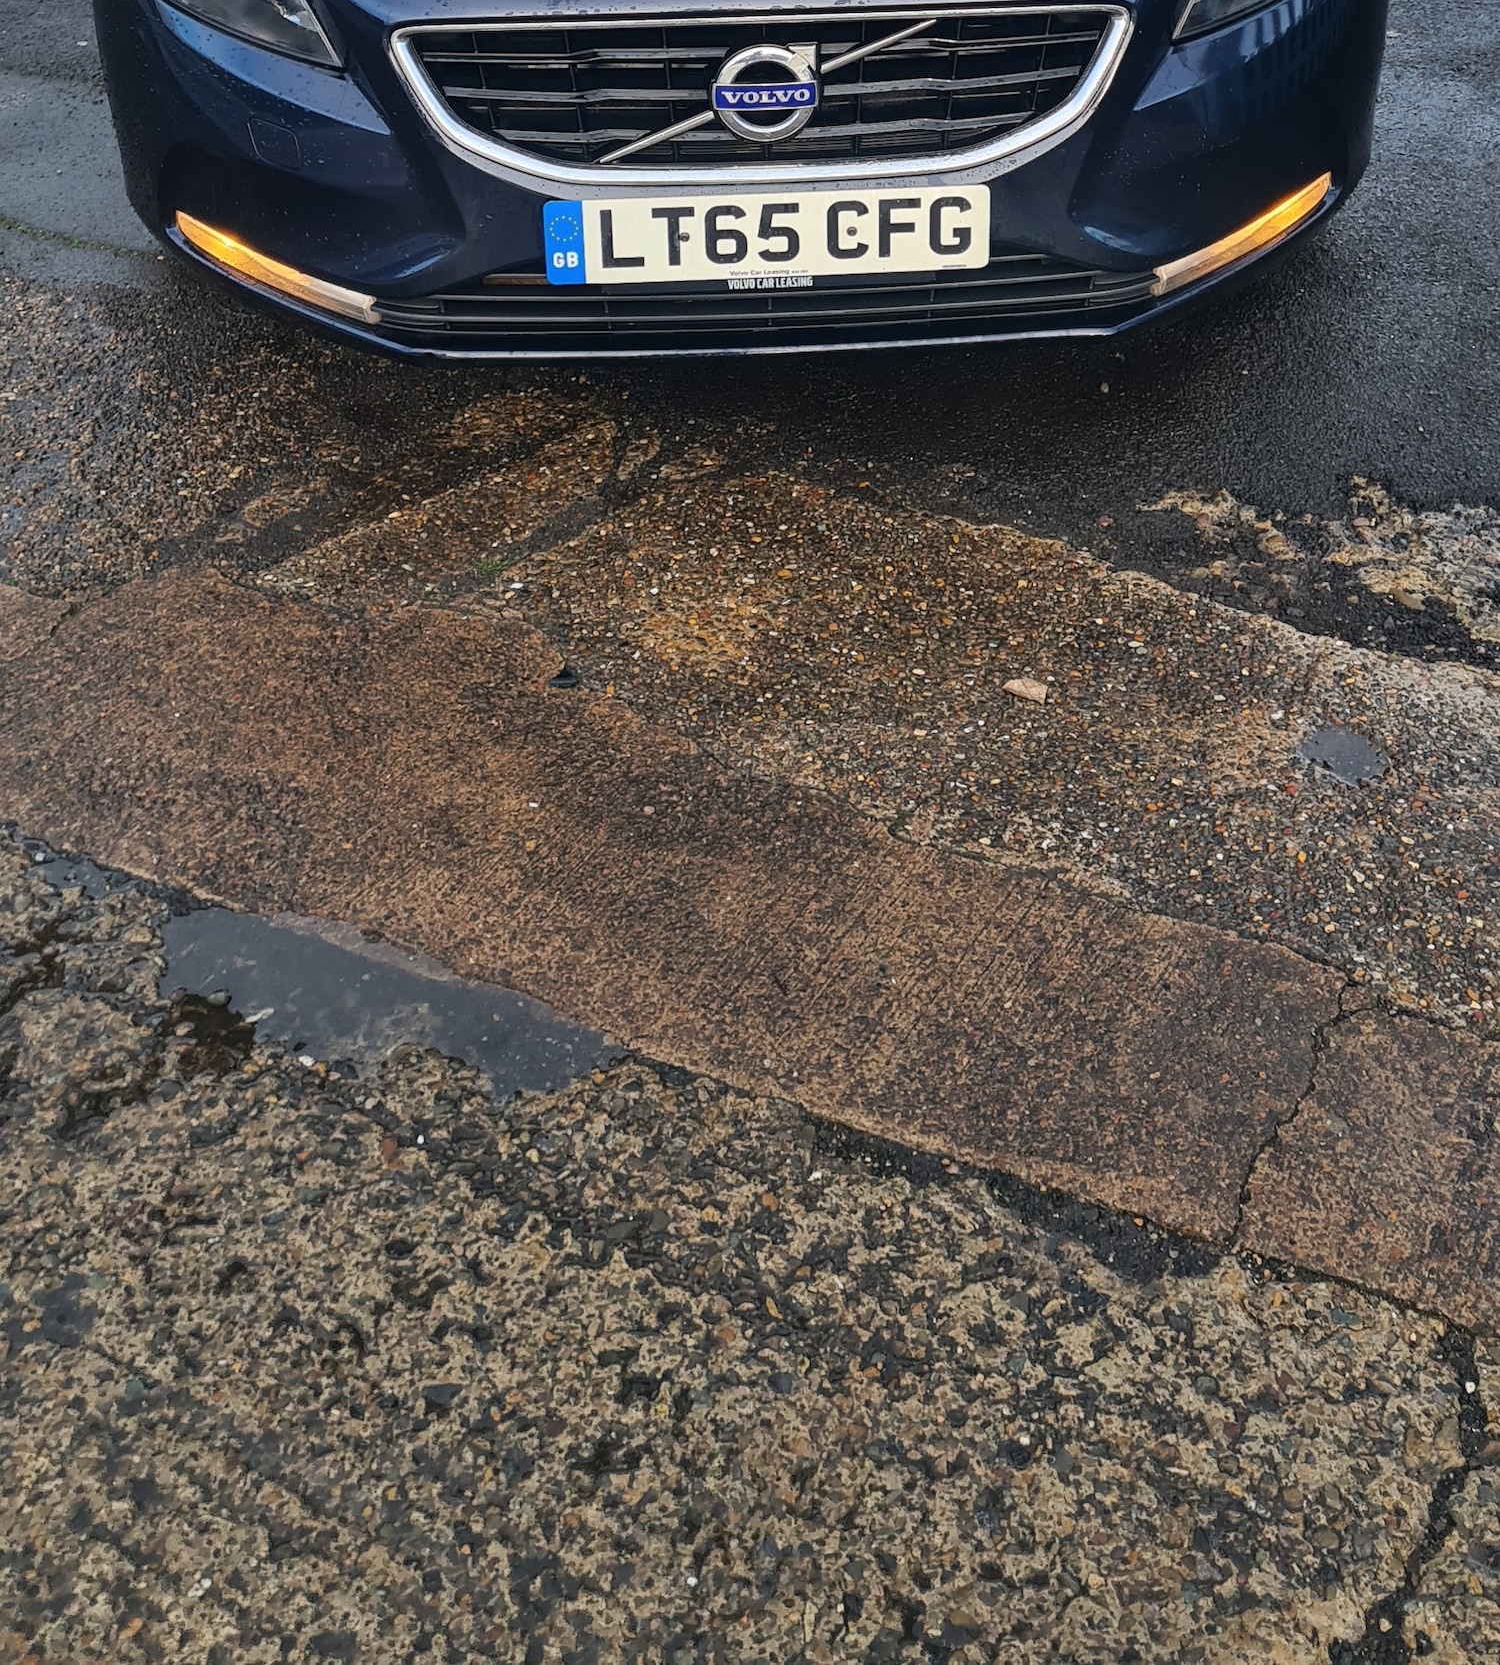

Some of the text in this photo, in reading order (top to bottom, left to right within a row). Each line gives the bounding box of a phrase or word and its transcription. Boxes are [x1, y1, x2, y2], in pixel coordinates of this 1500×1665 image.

[721, 88, 811, 104] VOLVO
[599, 196, 973, 269] LT65 CFG
[552, 251, 579, 269] GB
[727, 276, 814, 290] VOLVO CAR LEASING
